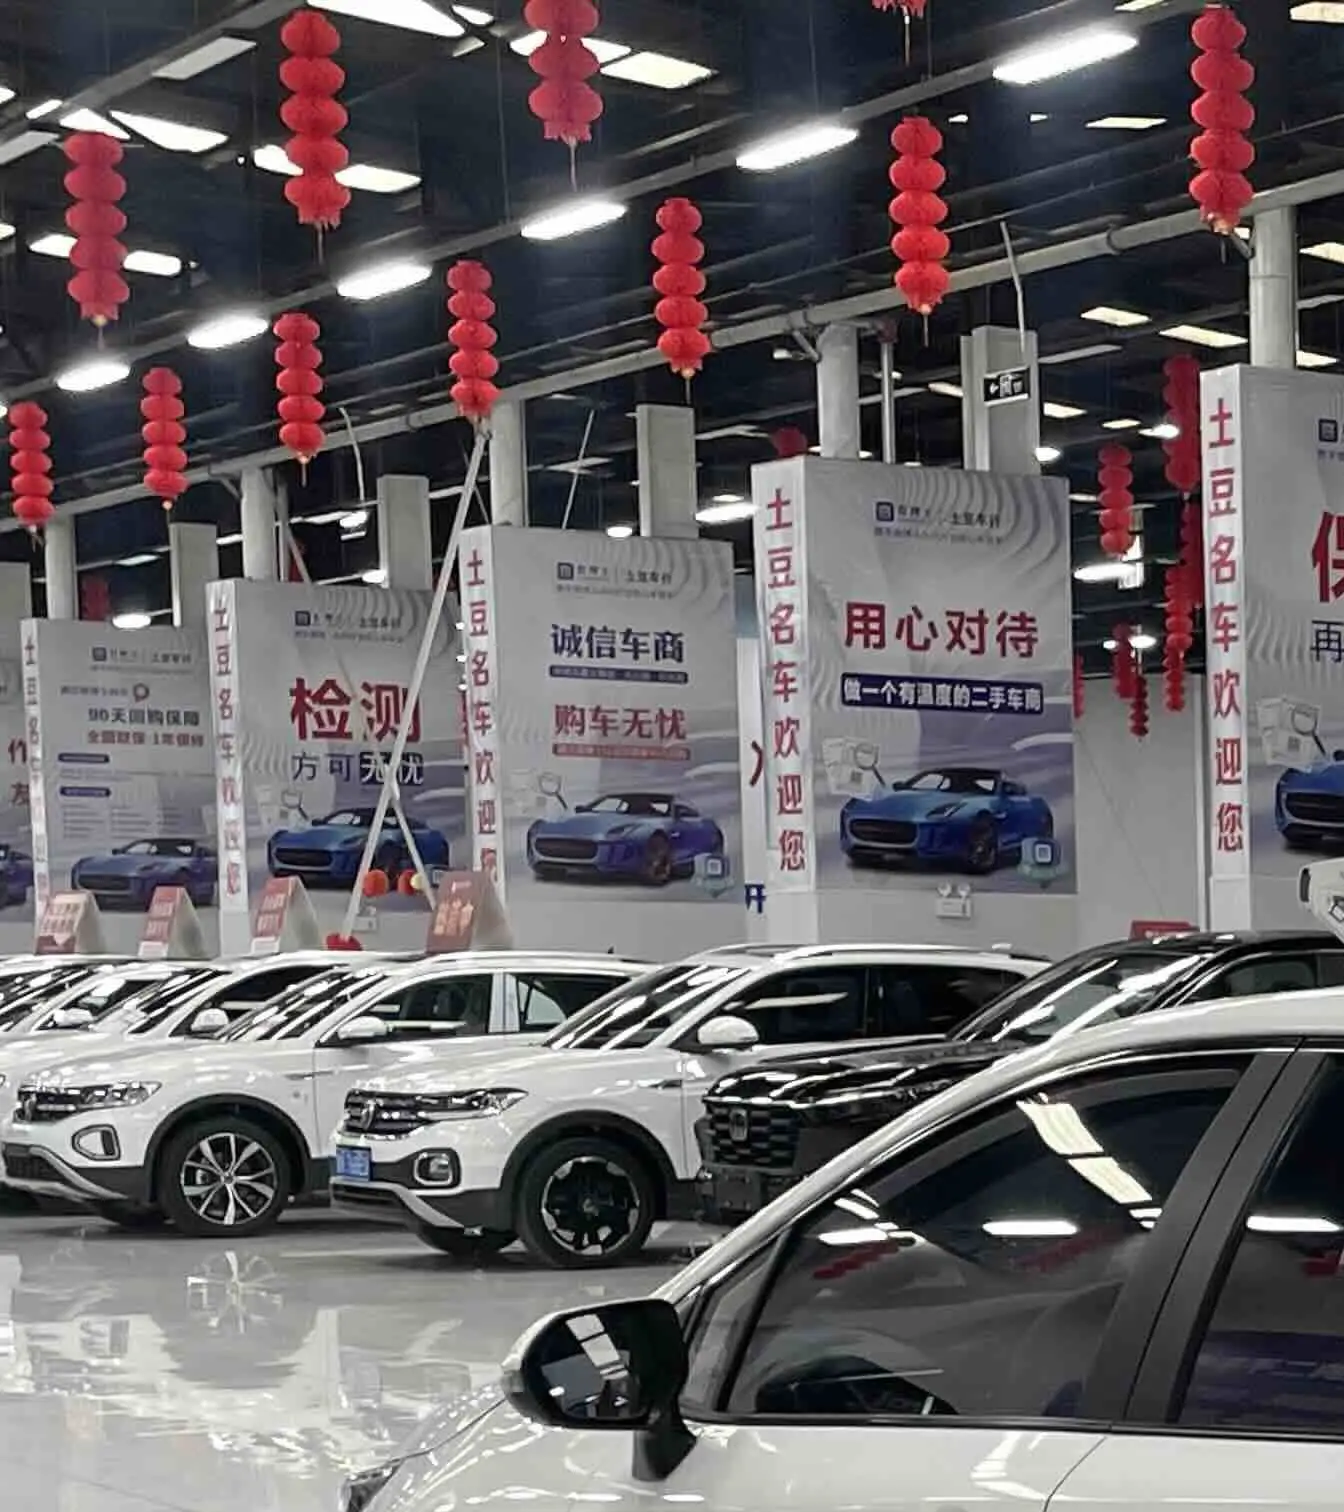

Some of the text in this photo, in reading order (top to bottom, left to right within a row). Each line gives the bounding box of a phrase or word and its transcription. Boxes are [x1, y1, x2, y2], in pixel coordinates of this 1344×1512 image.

[550, 623, 685, 664] 诚信车商
[844, 601, 1039, 660] 用心对待
[1208, 398, 1244, 852] 土豆名车欢迎您
[766, 488, 806, 872] 土豆名车欢迎您
[844, 677, 1042, 712] 做一个有温度的二手车商
[289, 677, 423, 743] 检测
[554, 704, 688, 741] 购车无忧
[292, 751, 424, 786] 方可无忧
